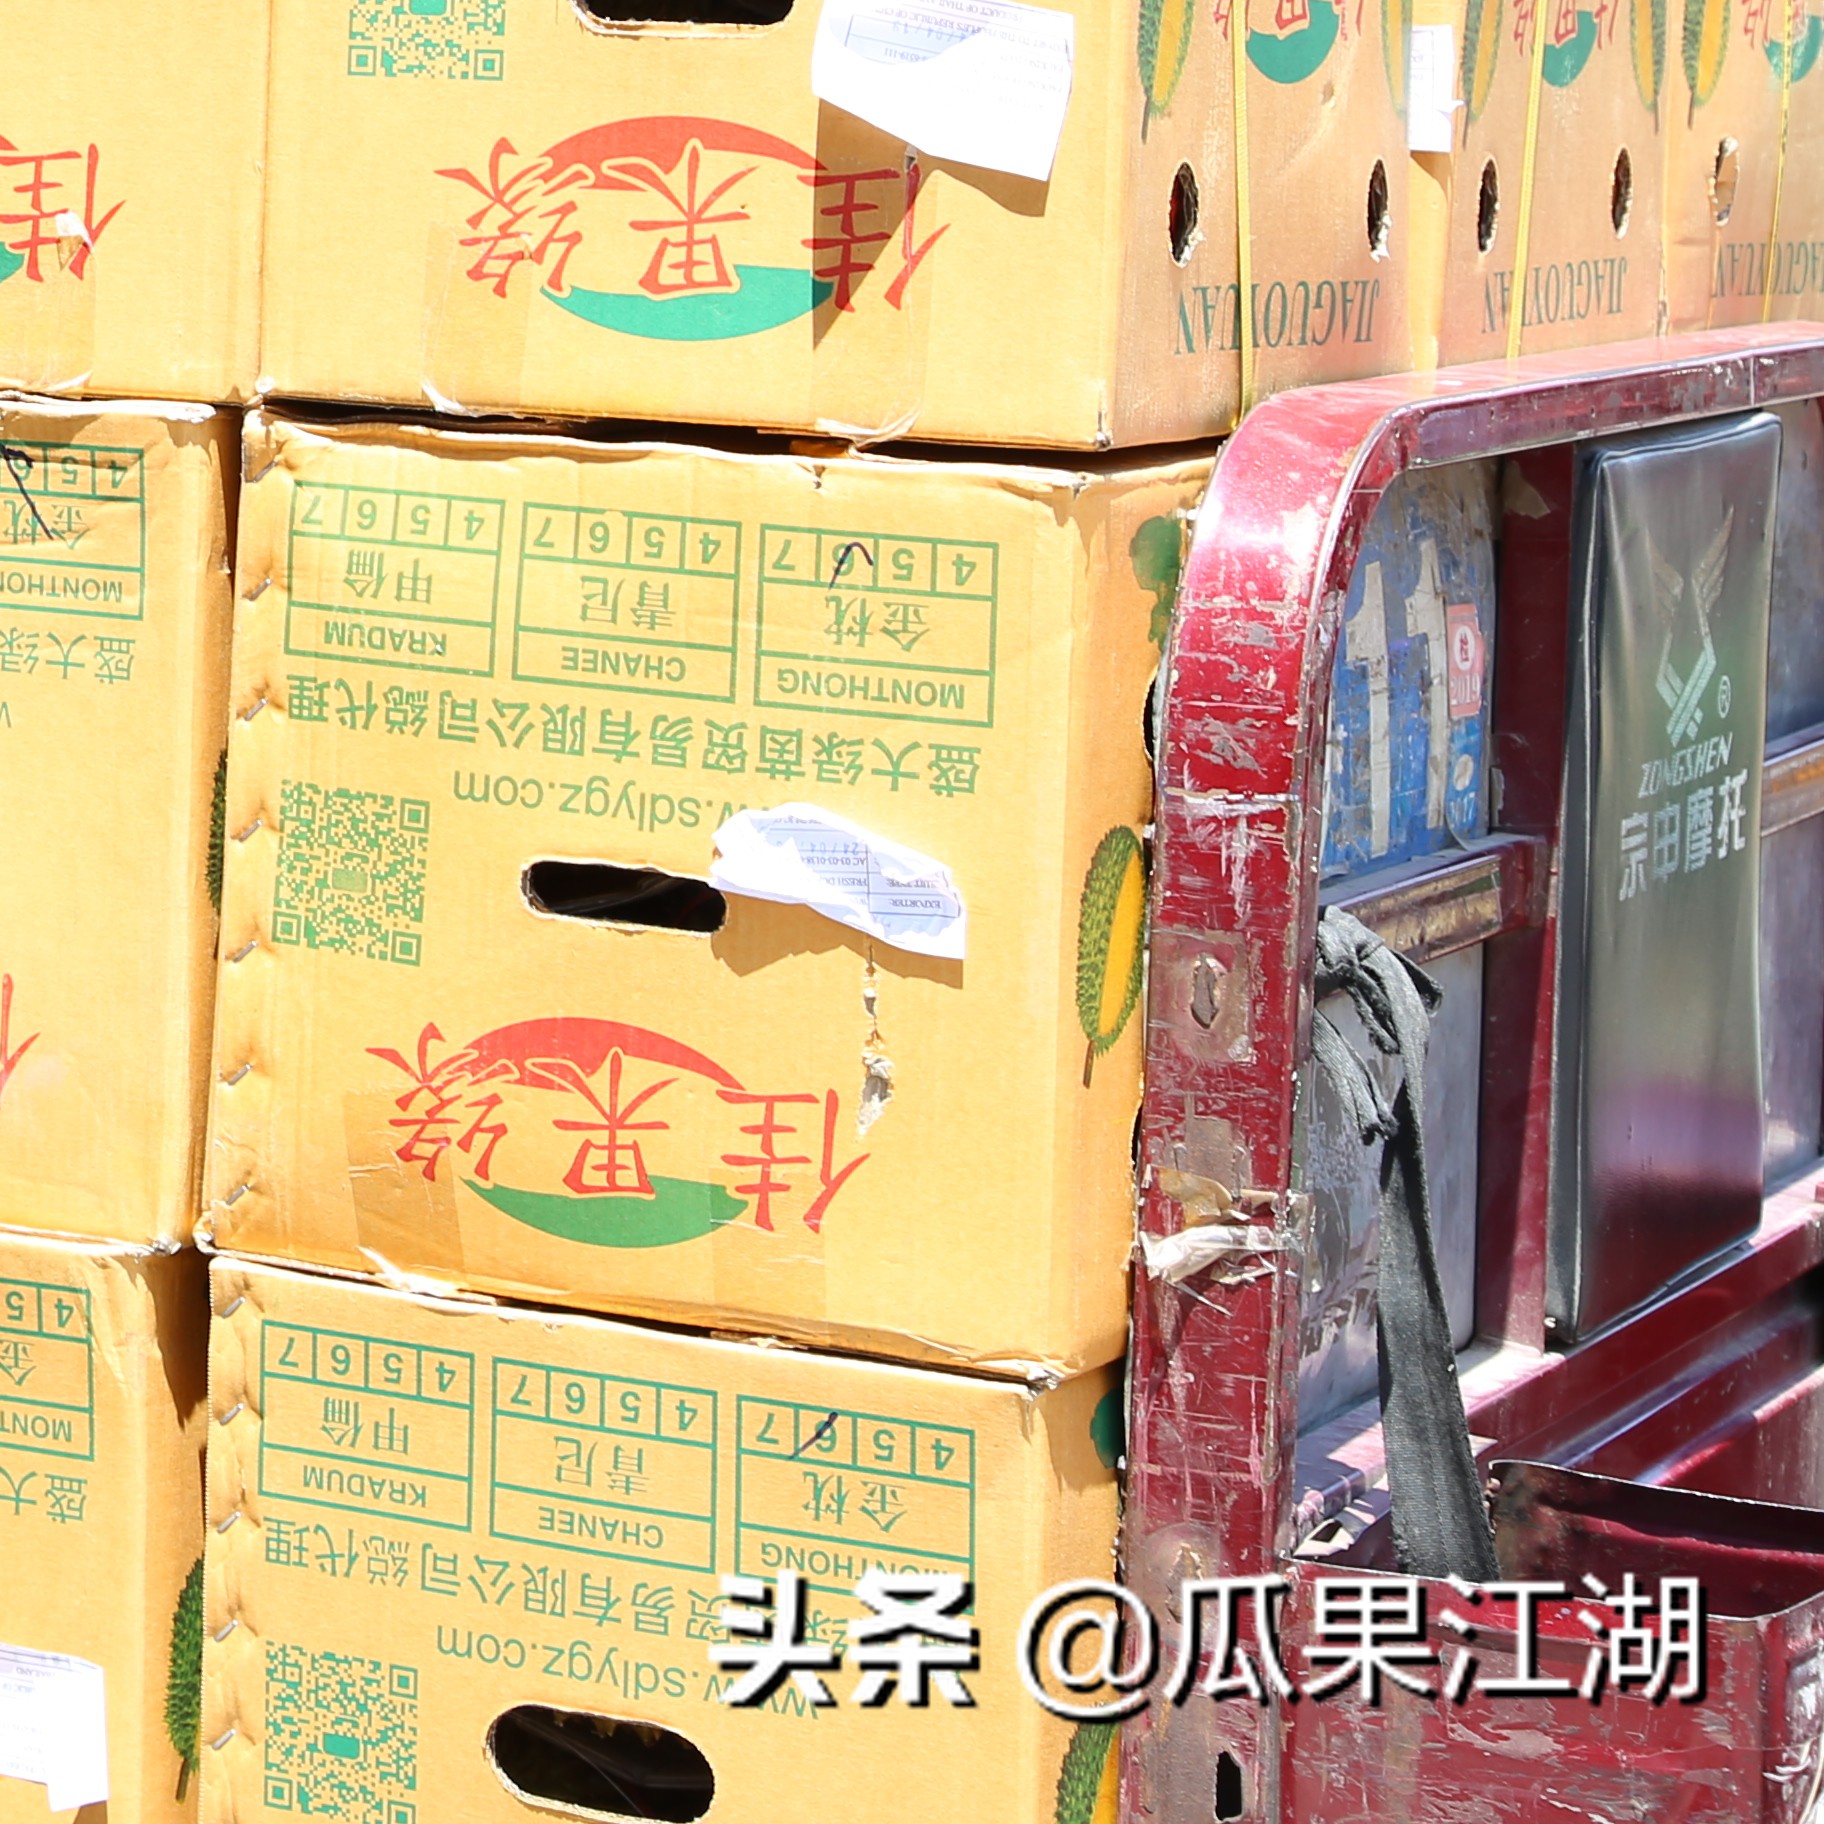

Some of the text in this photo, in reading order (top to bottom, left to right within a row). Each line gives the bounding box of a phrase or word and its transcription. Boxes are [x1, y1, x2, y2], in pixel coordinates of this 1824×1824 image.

[435, 136, 948, 312] 佳果缘
[575, 573, 678, 633] 青尼
[822, 593, 931, 655] 金枕
[324, 614, 448, 657] KRADUM
[561, 644, 686, 683] CHANEE
[776, 667, 967, 711] MONTHONG
[1638, 731, 1734, 799] ZONGSHEN
[1619, 769, 1748, 902] 宗申摩托
[365, 1021, 871, 1235] 佳果缘
[301, 1462, 428, 1509] KRADUM
[550, 1432, 653, 1500] 青尼
[538, 1504, 665, 1550] CHANEE
[800, 1468, 909, 1538] 金枕
[759, 1538, 951, 1598] ONTHONG
